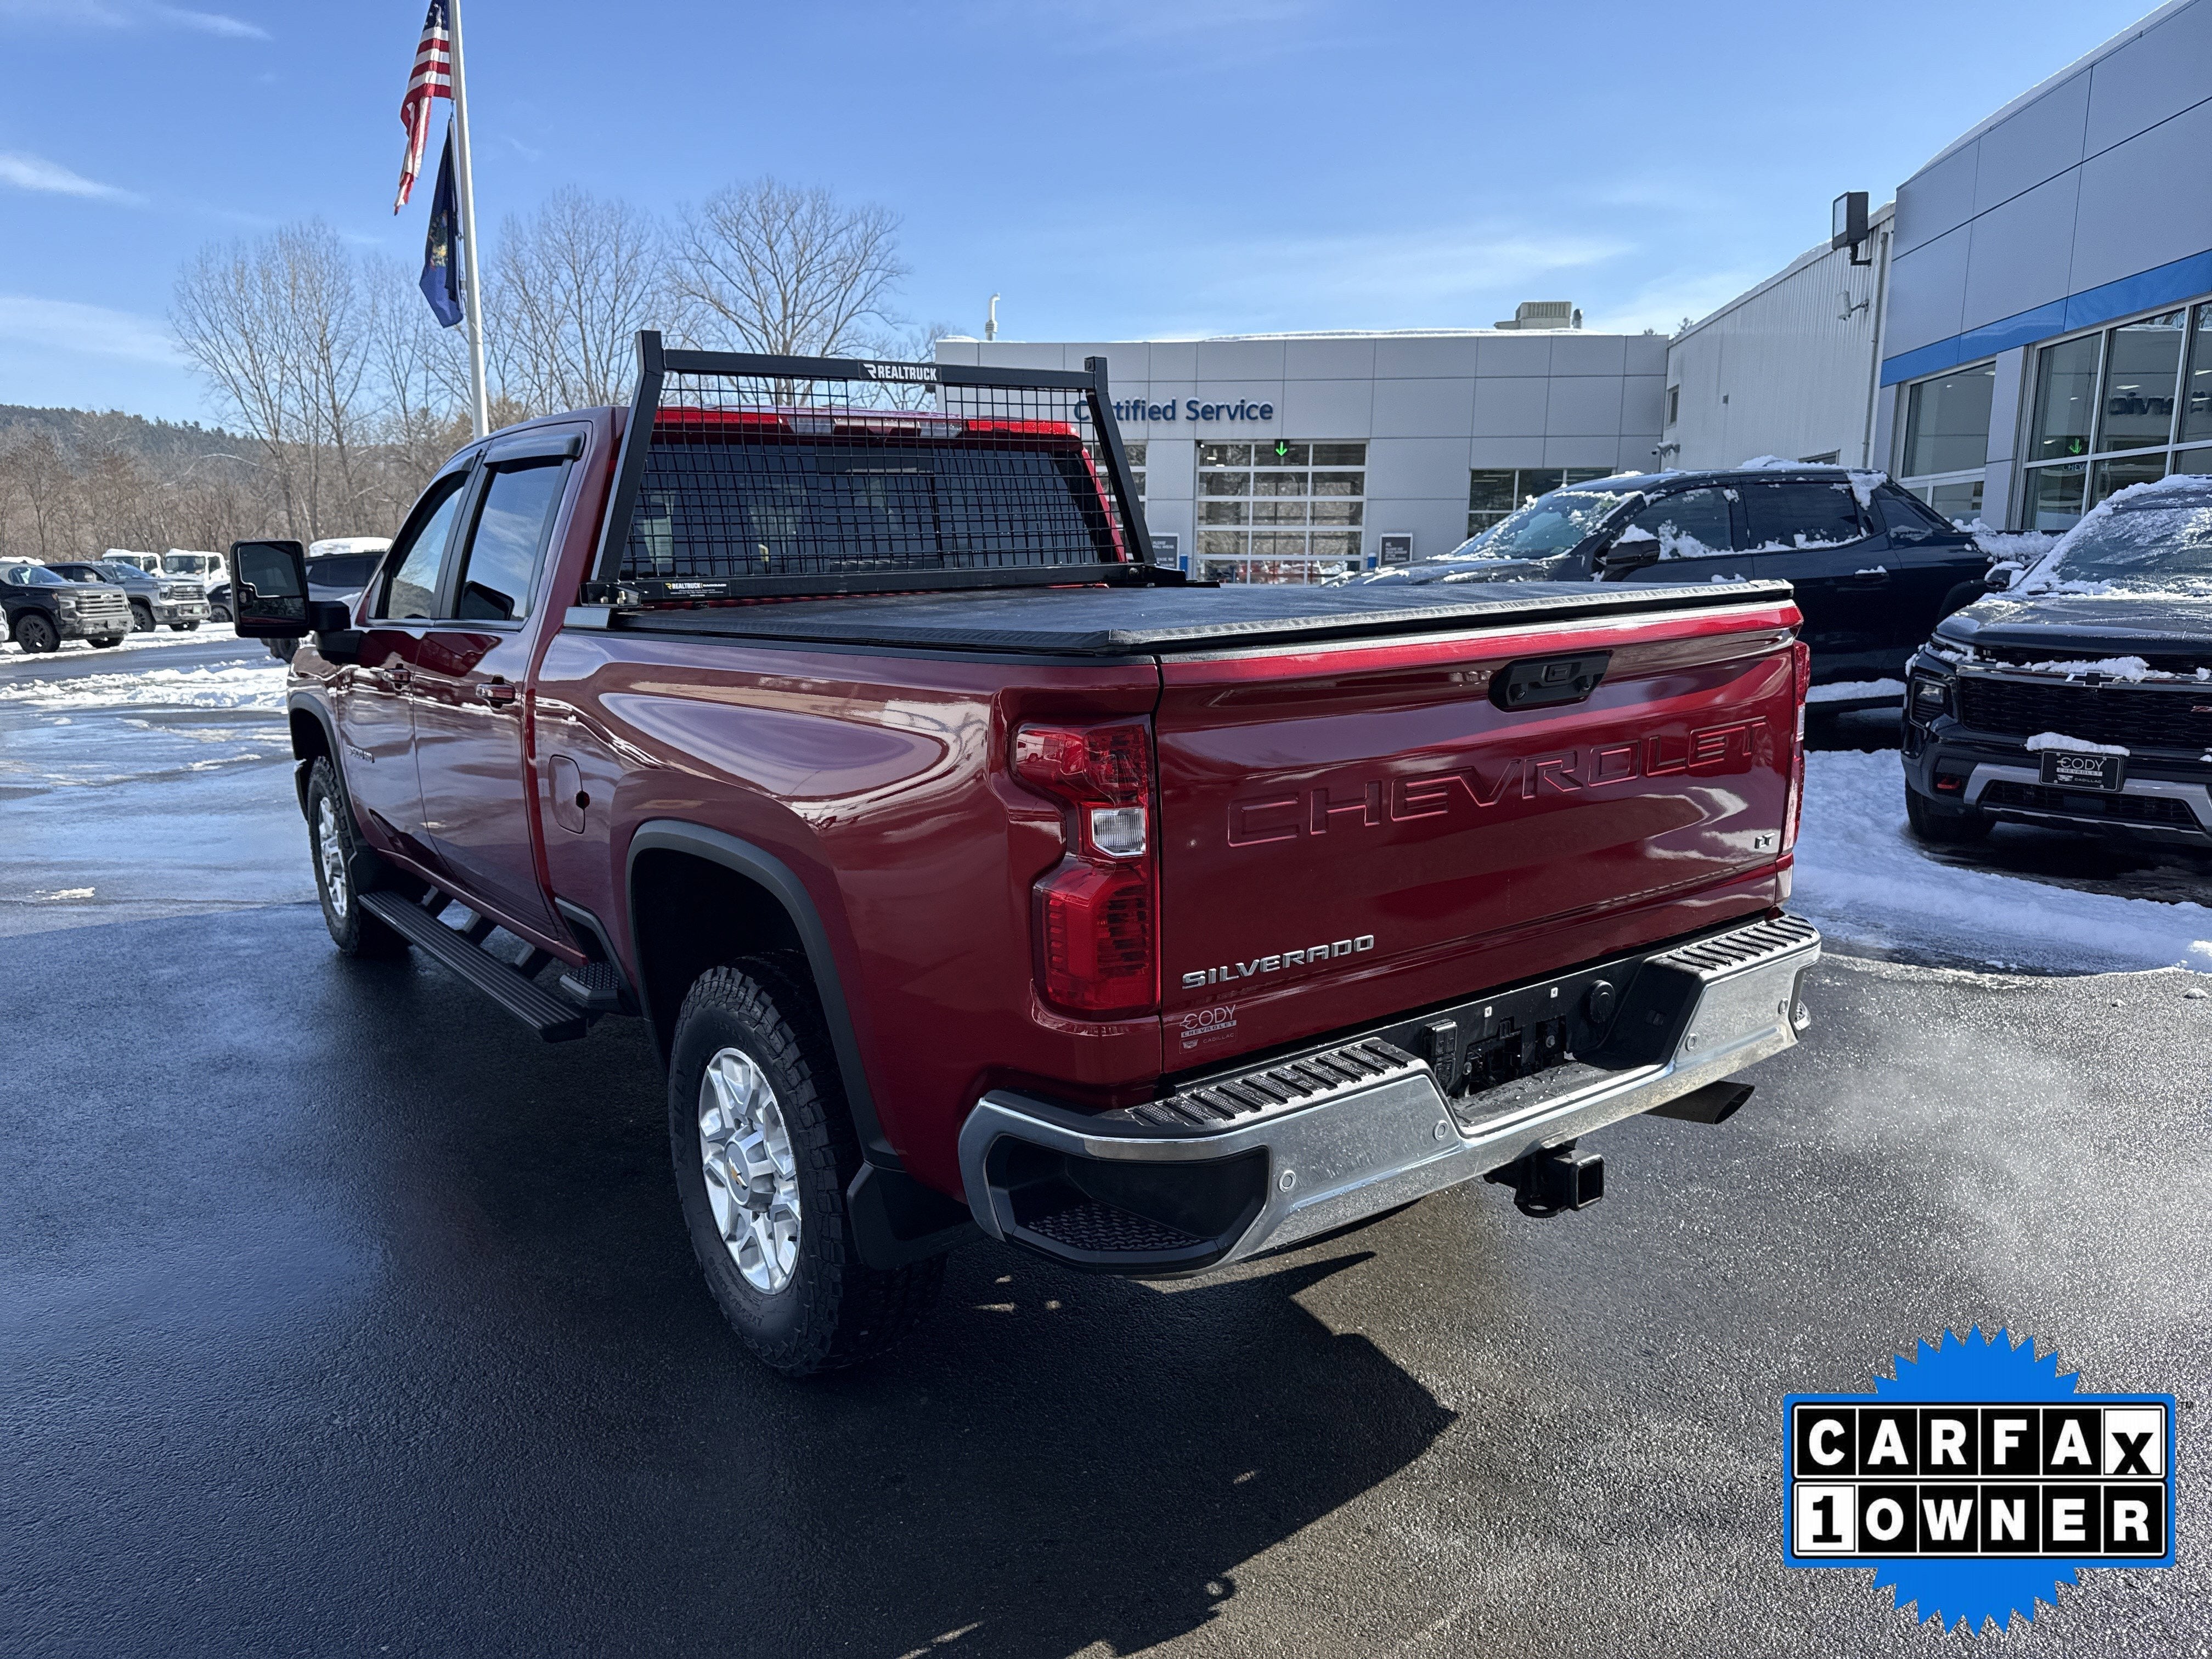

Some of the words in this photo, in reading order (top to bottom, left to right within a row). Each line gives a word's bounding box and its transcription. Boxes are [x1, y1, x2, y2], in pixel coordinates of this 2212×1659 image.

[878, 365, 938, 381] REALTRUCK
[1074, 399, 1176, 421] Ctified
[1186, 399, 1273, 421] Service
[2057, 757, 2104, 771] CODY
[1227, 716, 1768, 848] CHEVROLET
[1754, 833, 1775, 849] LT
[1182, 934, 1374, 989] SILVERADO
[1180, 1005, 1236, 1030] CODY
[1183, 1020, 1235, 1037] CHEVROLET
[1203, 1032, 1235, 1043] CADILLAC
